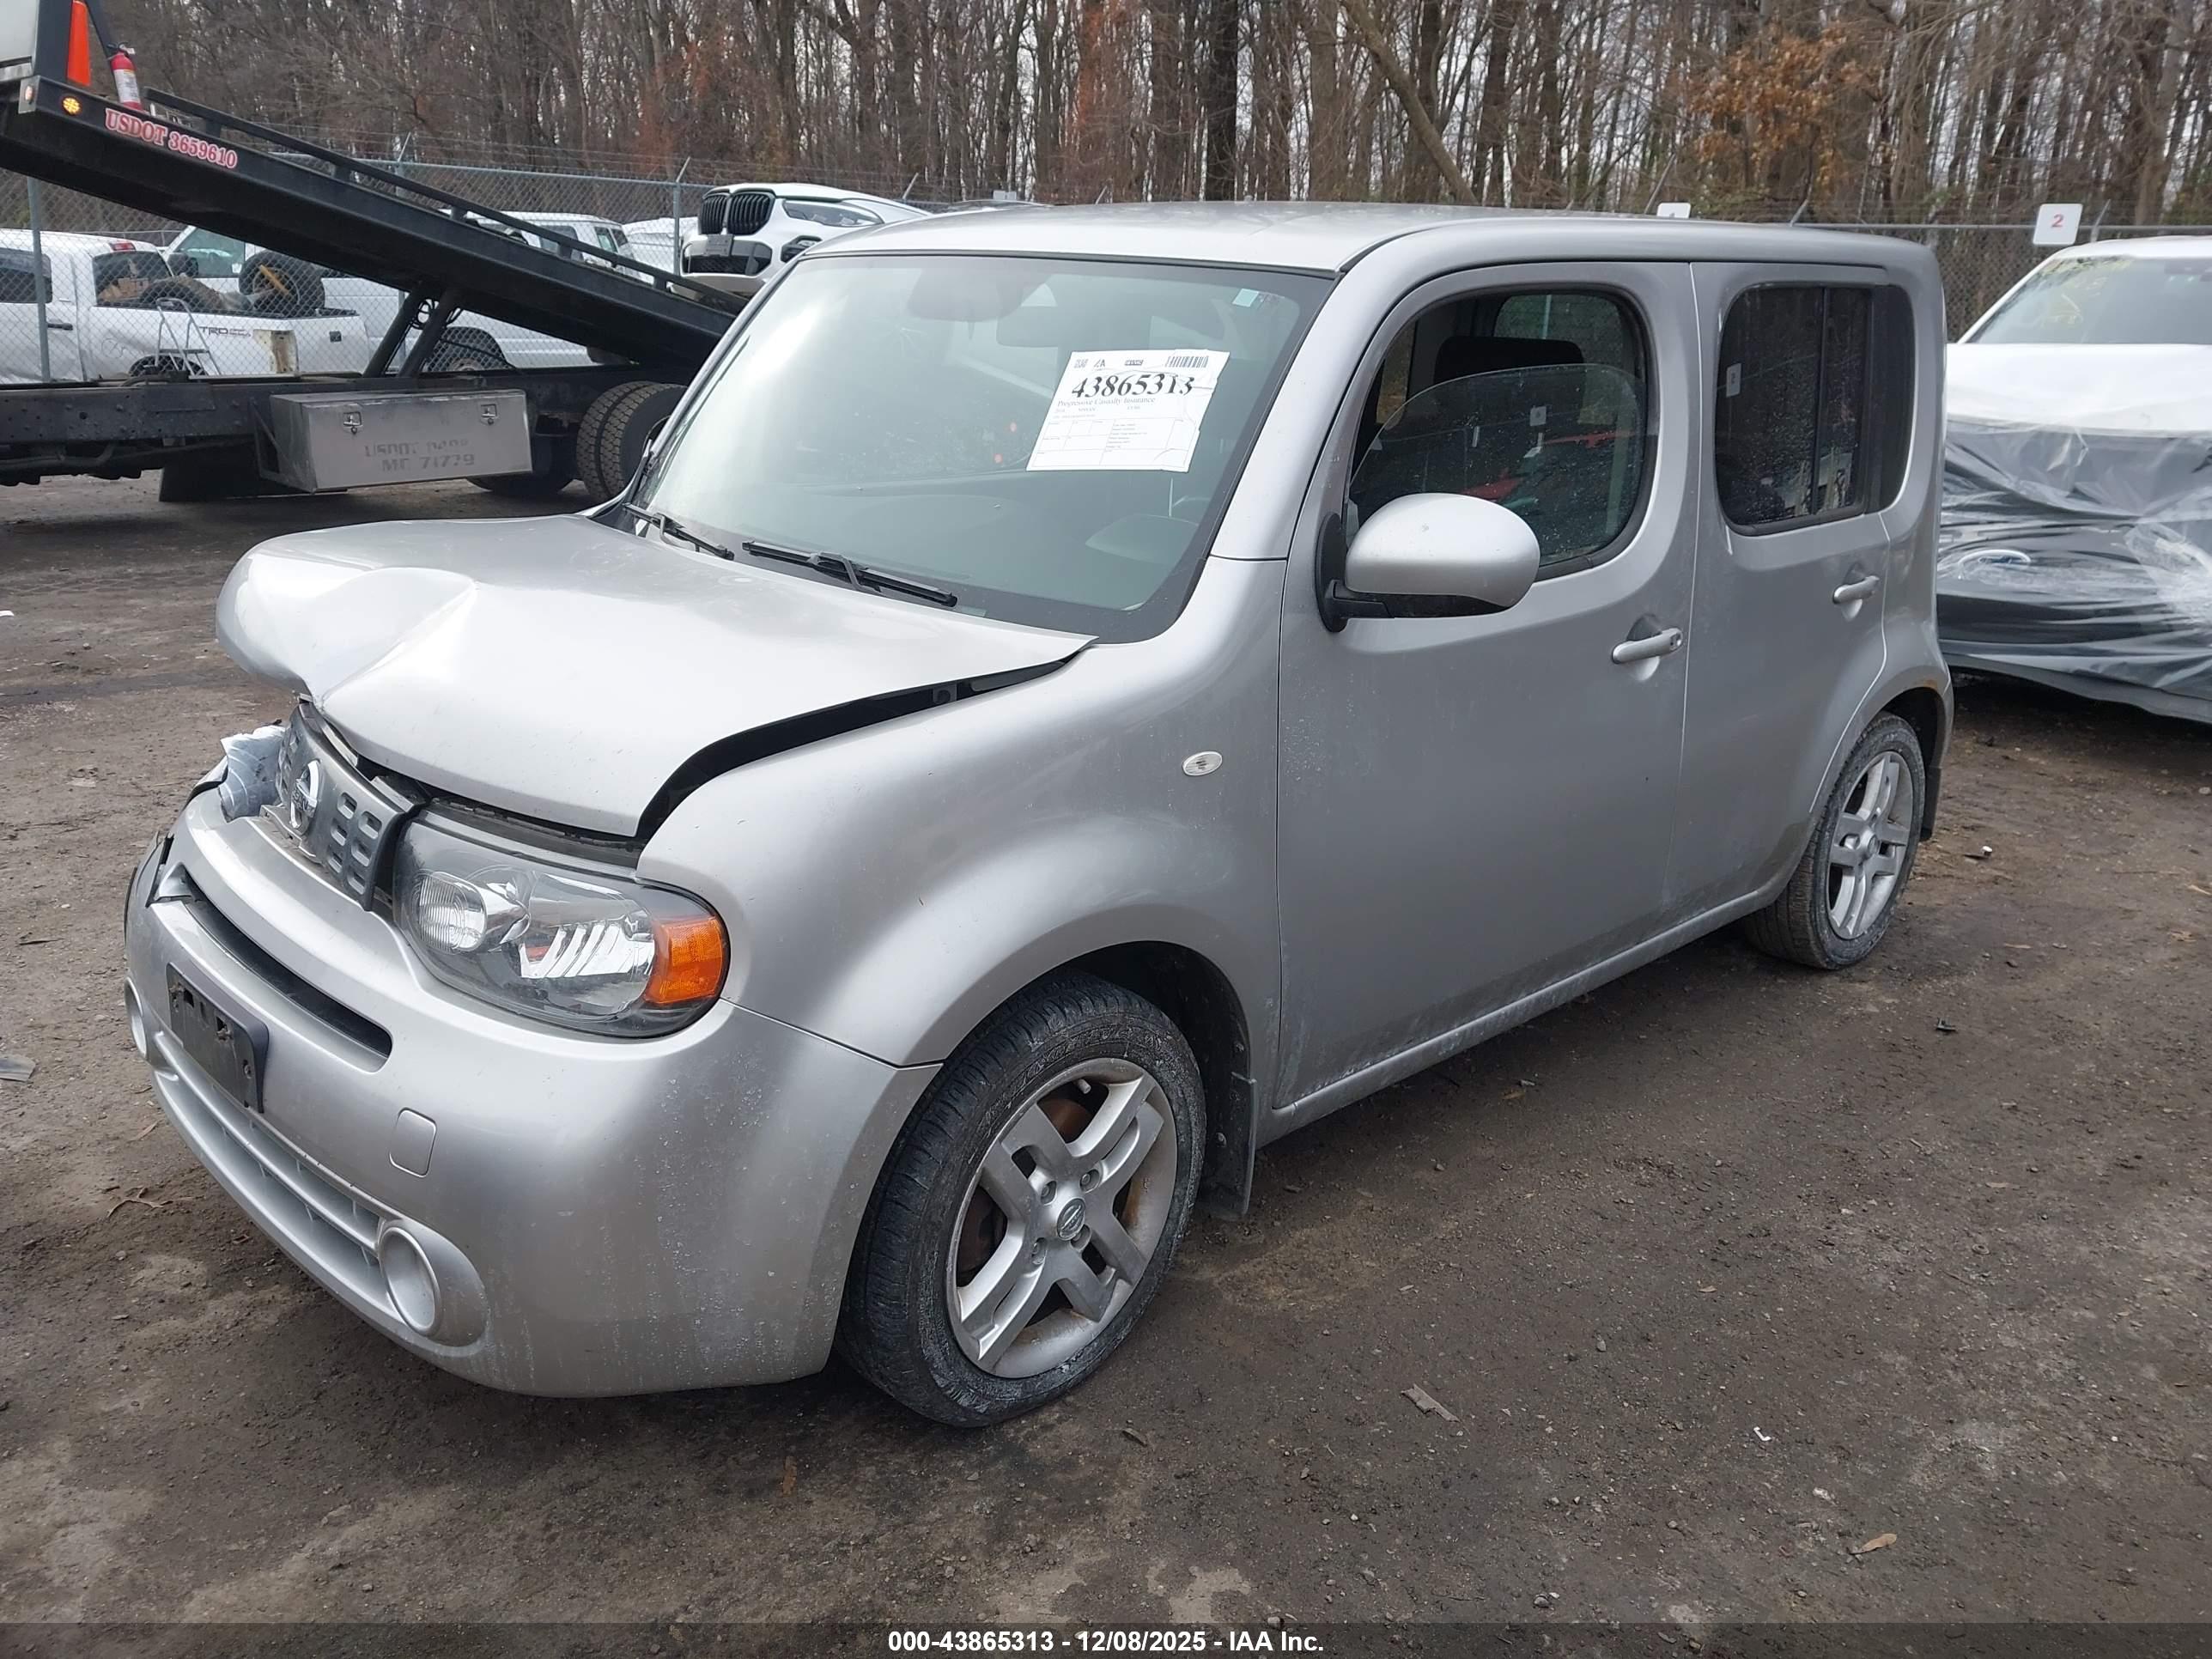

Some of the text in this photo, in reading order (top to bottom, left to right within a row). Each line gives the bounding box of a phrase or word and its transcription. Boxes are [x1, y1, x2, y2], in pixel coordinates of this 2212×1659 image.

[106, 108, 238, 168] USDOT 3659610
[2051, 214, 2064, 228] 2
[1072, 373, 1195, 398] 43865313
